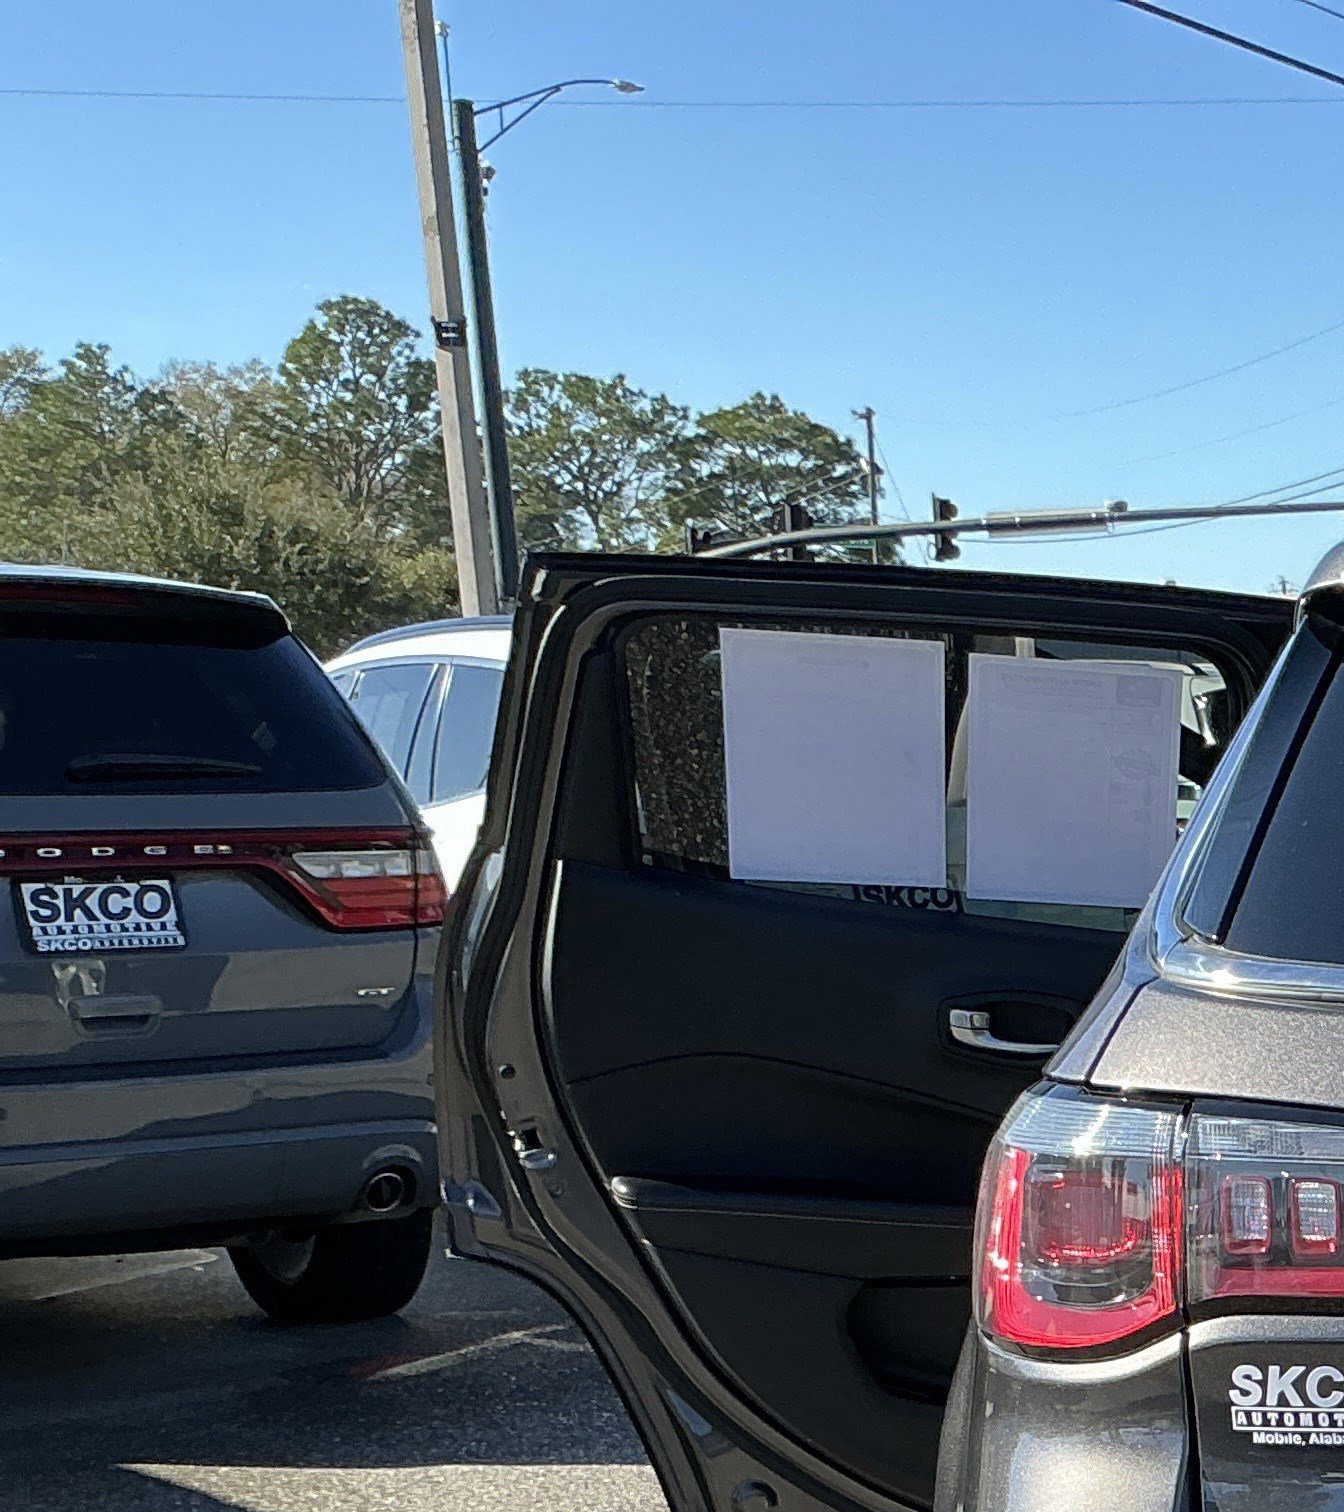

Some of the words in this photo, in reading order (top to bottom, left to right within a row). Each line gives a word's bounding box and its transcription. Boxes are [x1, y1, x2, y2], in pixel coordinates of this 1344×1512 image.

[0, 844, 214, 858] ODGE
[29, 884, 172, 923] SKCO
[37, 938, 93, 951] SKCO
[1252, 1432, 1306, 1447] Mobile,
